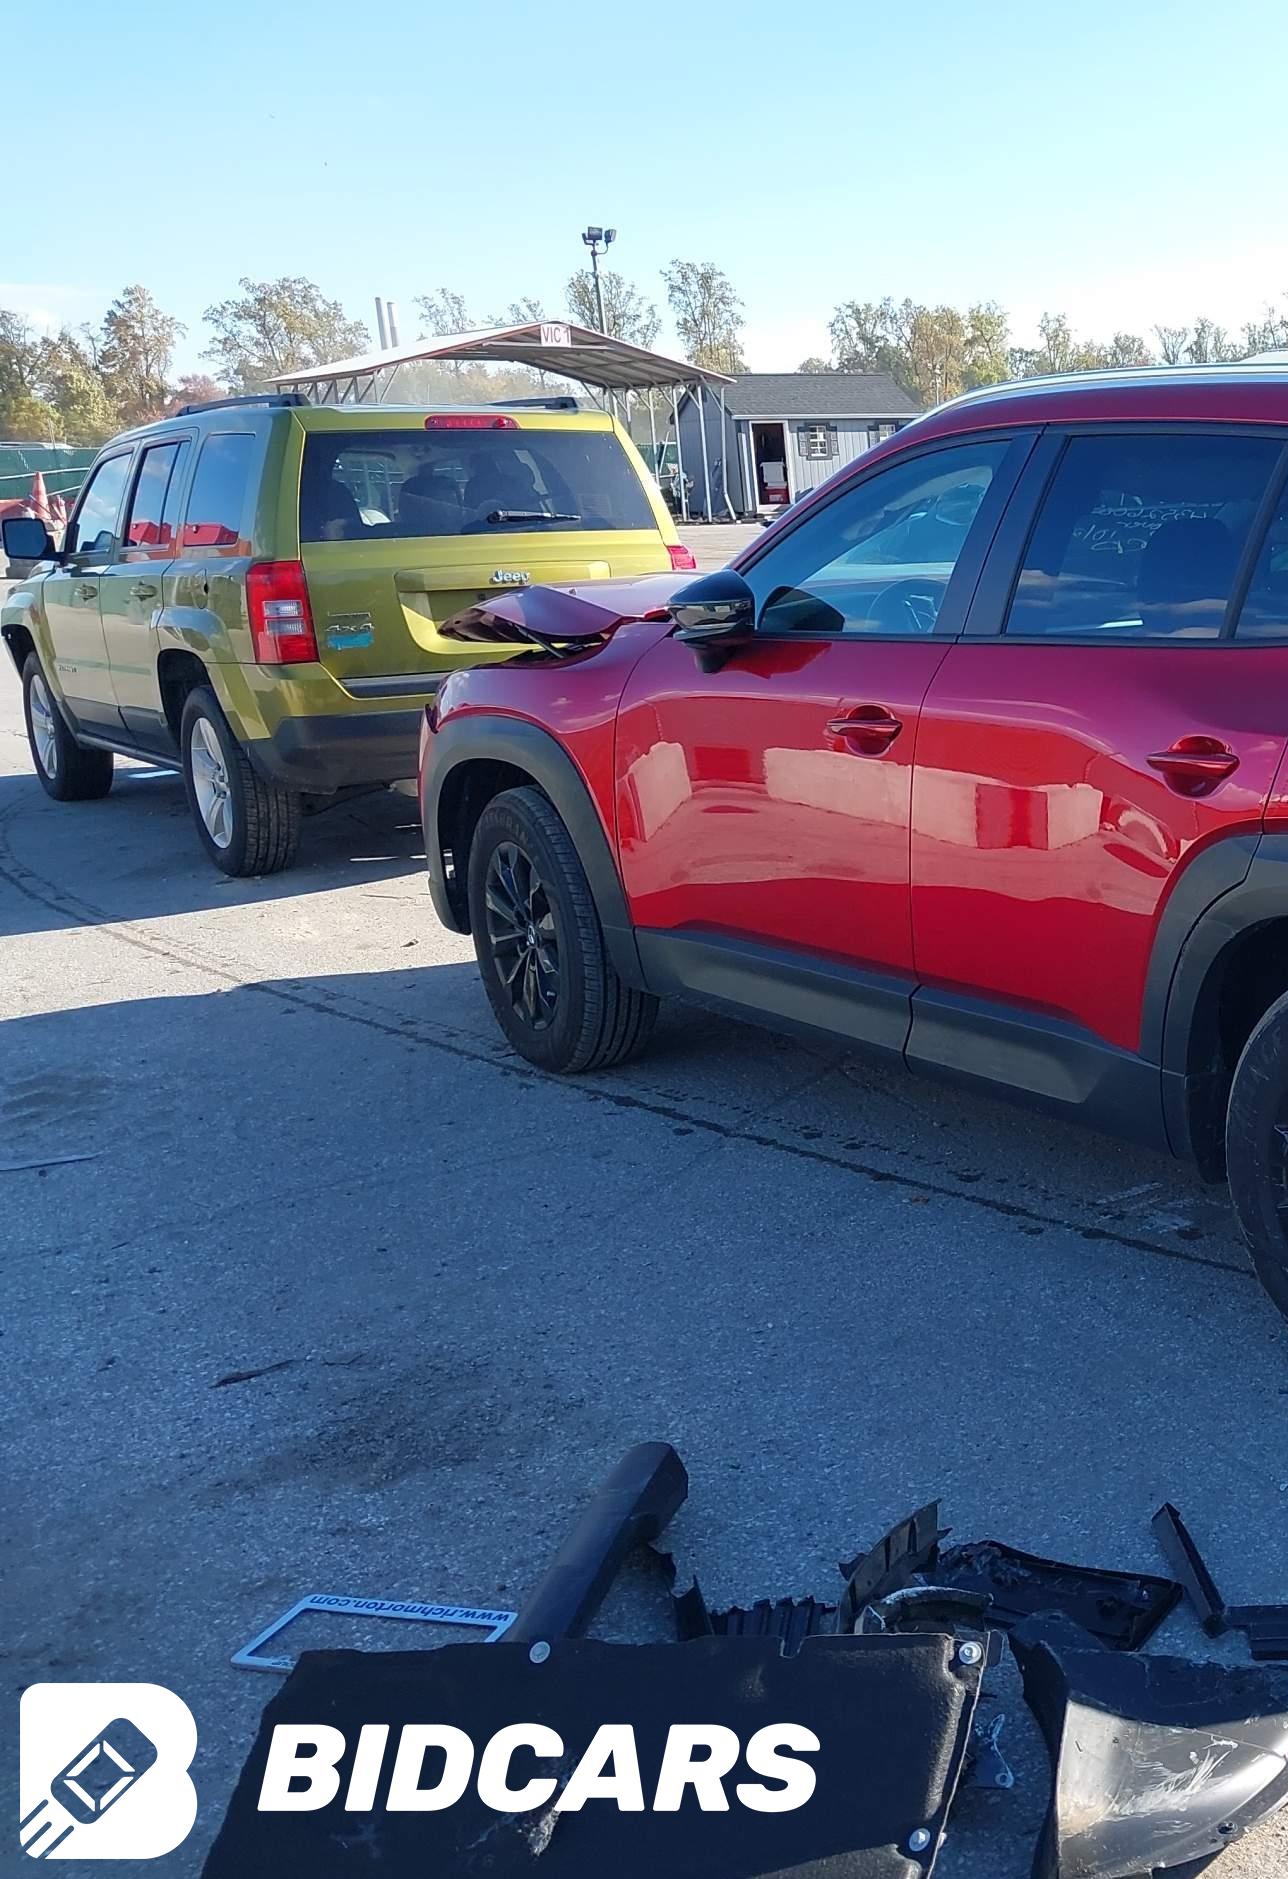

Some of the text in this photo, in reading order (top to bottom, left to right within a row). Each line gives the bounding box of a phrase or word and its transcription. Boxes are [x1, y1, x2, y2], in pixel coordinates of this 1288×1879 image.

[541, 326, 570, 344] VIC 1
[492, 569, 531, 585] Jeep
[309, 1596, 511, 1622] www.richmorton.com
